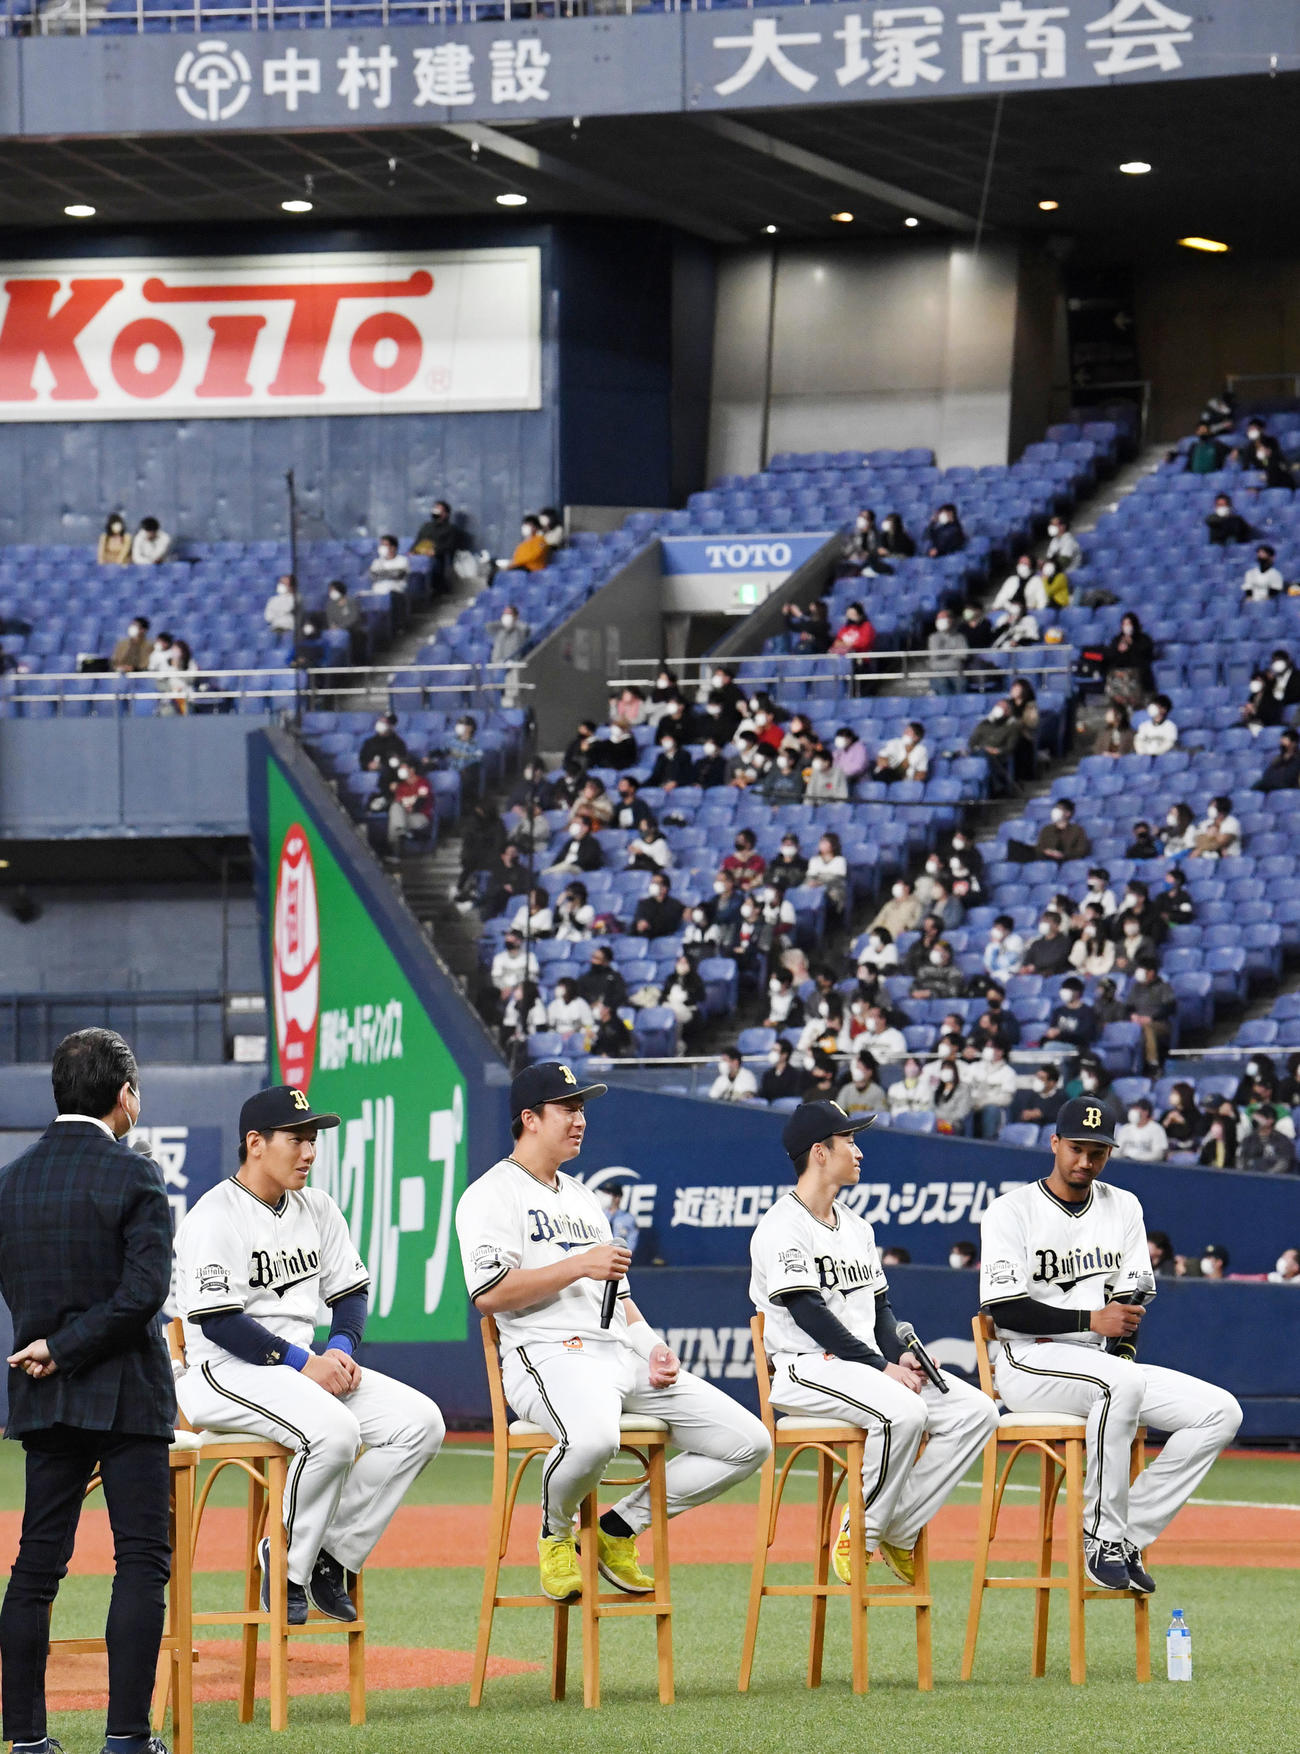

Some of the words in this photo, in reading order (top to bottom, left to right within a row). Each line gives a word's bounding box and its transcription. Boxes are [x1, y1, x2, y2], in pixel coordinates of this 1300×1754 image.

[713, 0, 1193, 95] 大塚商会
[263, 39, 551, 112] 中村建設
[705, 542, 792, 568] TOTO
[1082, 1106, 1102, 1129] B
